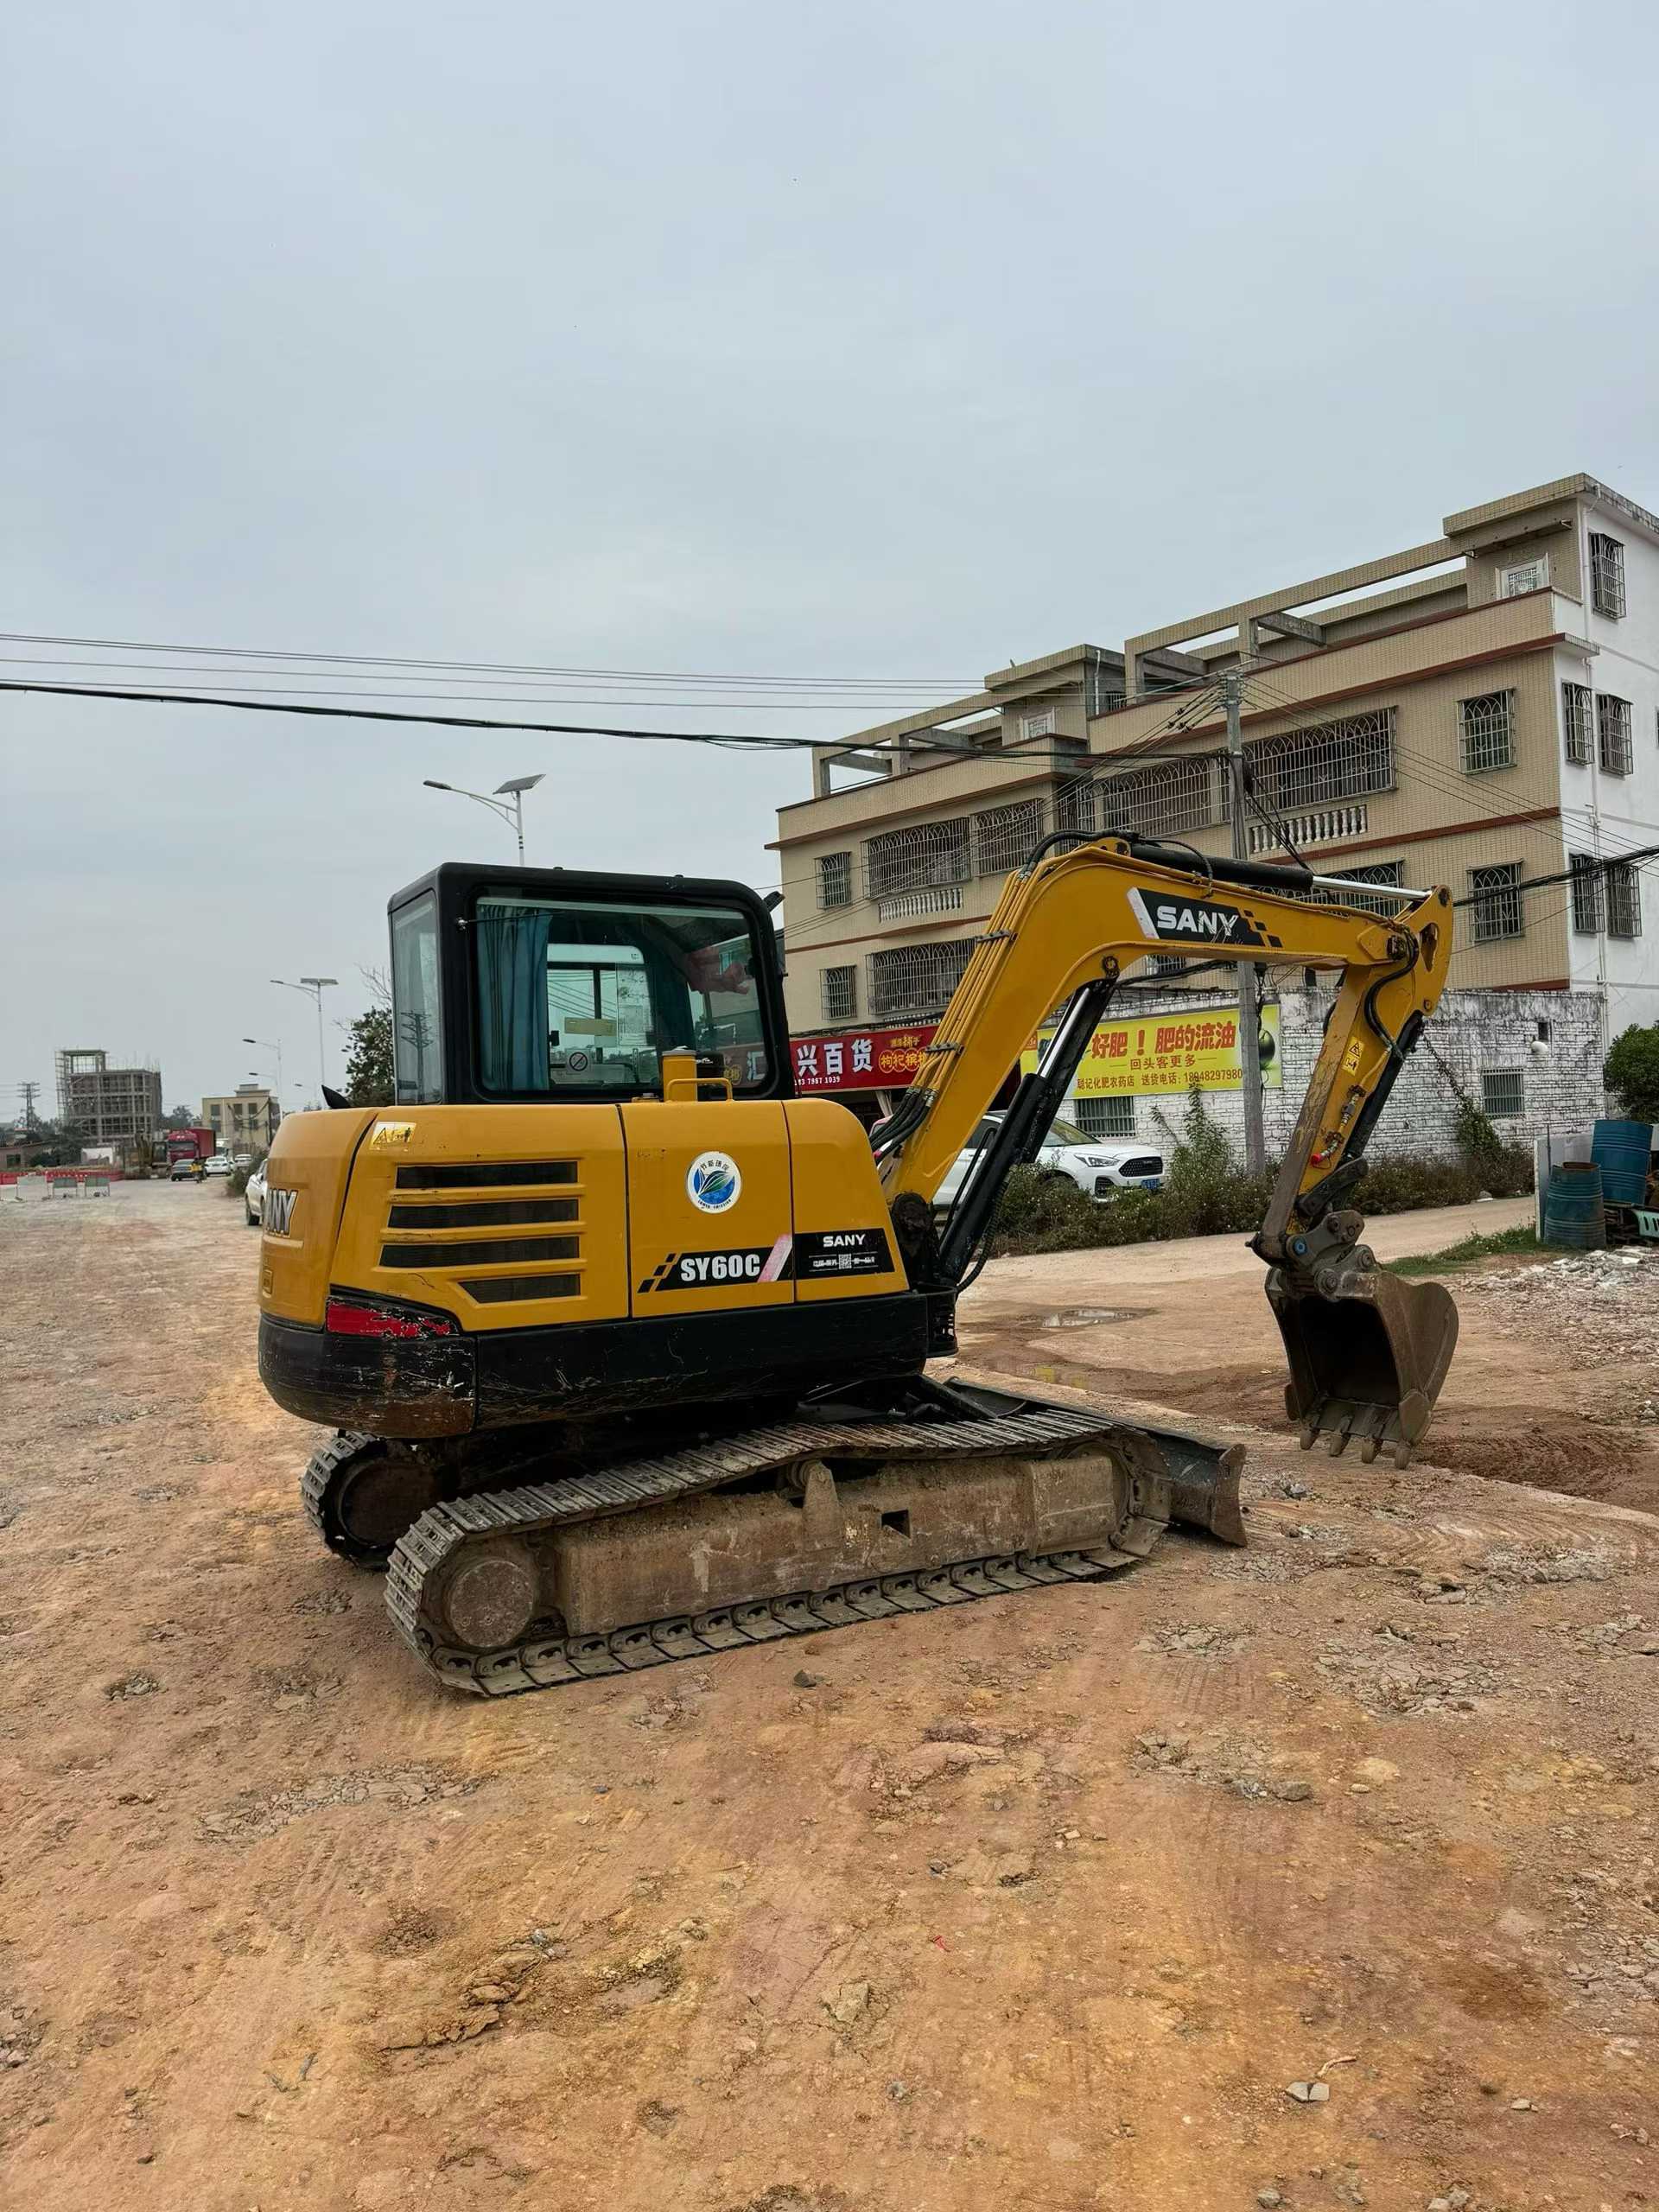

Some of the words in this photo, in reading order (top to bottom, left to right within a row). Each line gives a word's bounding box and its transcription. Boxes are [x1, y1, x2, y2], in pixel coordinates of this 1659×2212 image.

[1156, 905, 1239, 937] SANY
[796, 1039, 873, 1077] 兴百货
[1129, 1052, 1197, 1071] 回头客更多
[823, 1233, 866, 1248] SANY
[680, 1253, 761, 1282] SY60C
